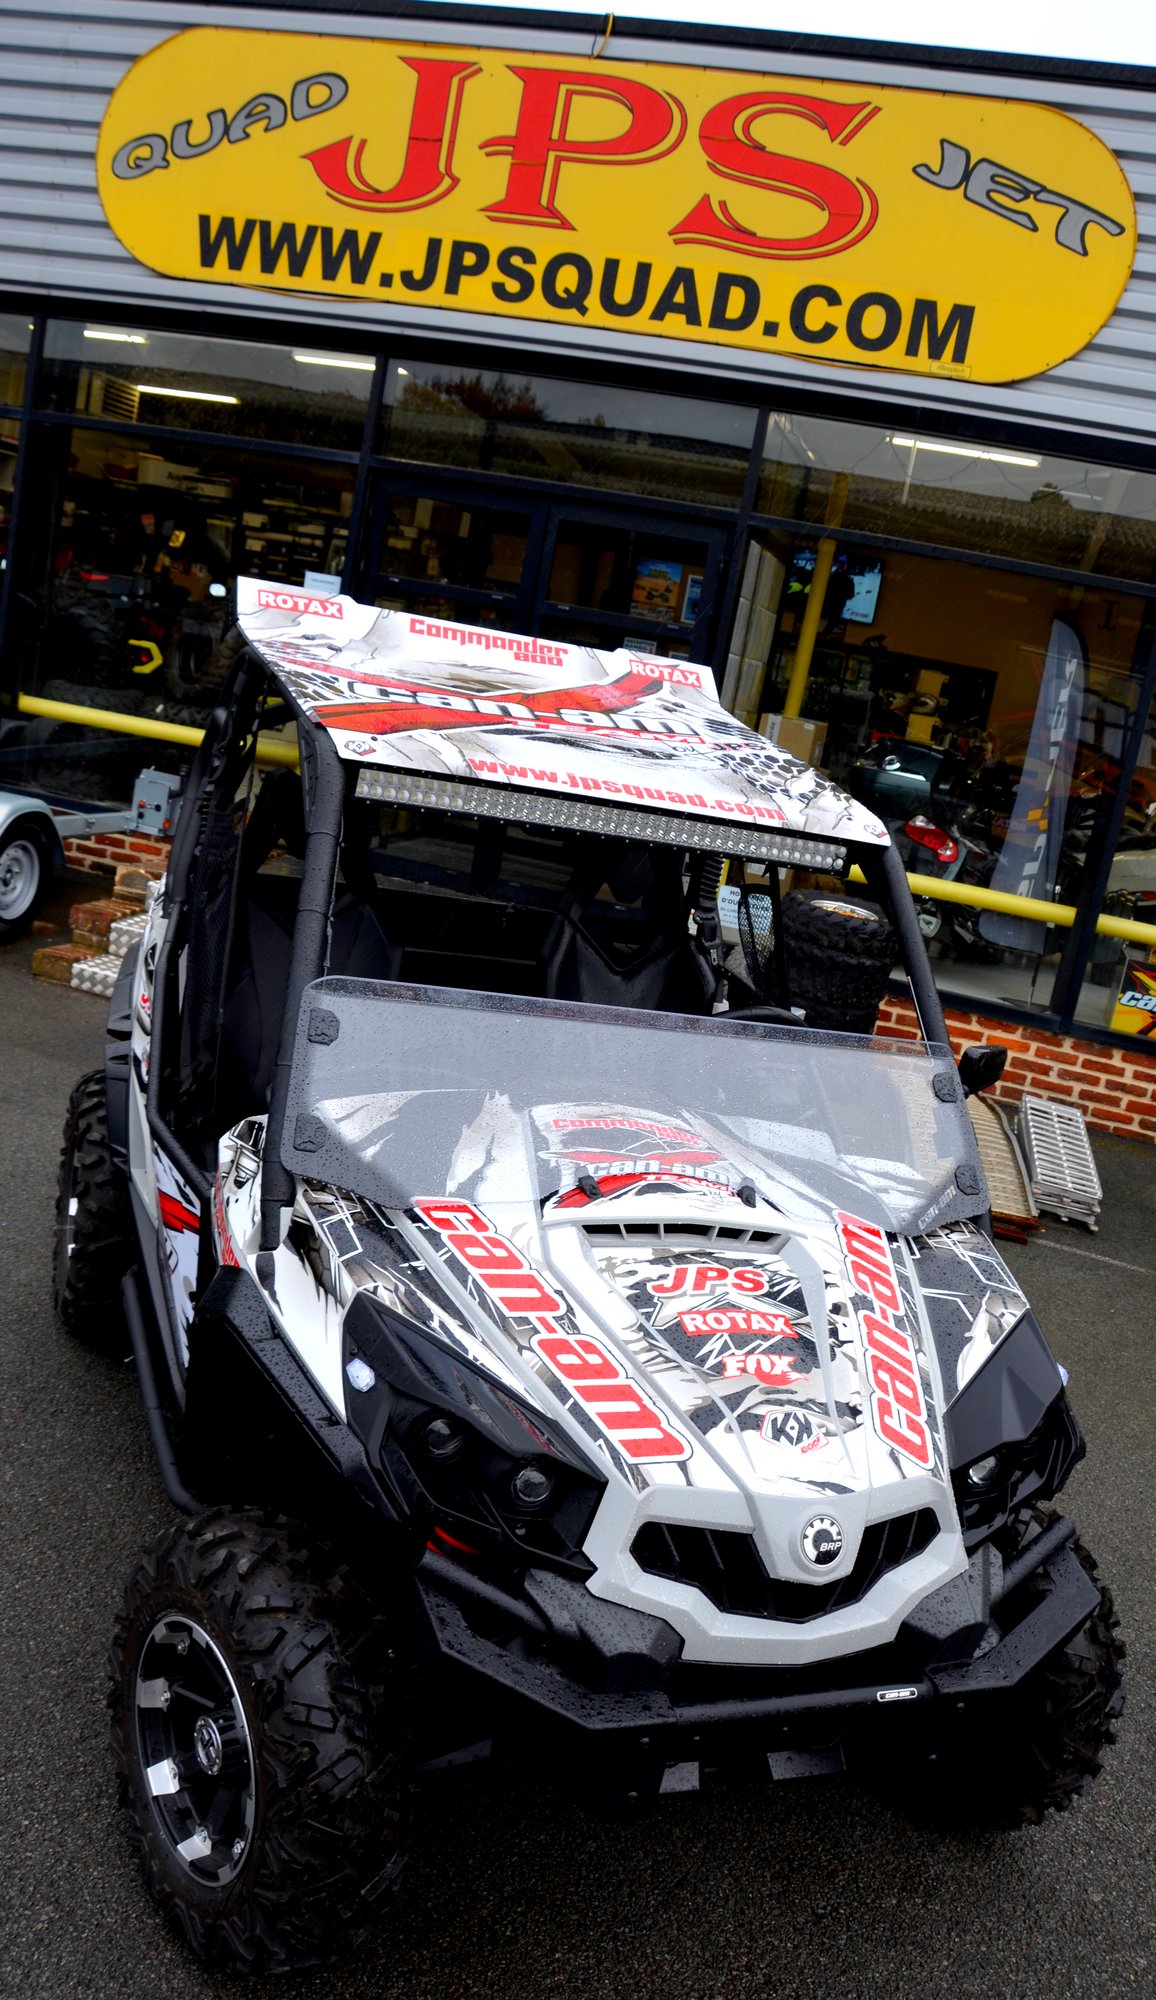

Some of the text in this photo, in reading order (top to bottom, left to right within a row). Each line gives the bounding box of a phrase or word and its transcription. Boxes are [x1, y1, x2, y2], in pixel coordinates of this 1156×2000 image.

[112, 72, 349, 180] QUAD
[300, 56, 882, 260] JPS
[912, 138, 1126, 257] JET
[198, 213, 976, 364] WWW.JPSQUAD.COM
[258, 590, 342, 619] ROTAX
[409, 617, 569, 657] Commander
[513, 651, 564, 667] 800
[630, 661, 700, 686] ROTAX
[468, 757, 786, 821] www.jpsquad.com
[651, 1266, 769, 1293] JPS
[414, 1198, 685, 1459] can-am
[681, 1312, 792, 1336] ROTAX
[836, 1211, 930, 1465] can-am
[723, 1354, 797, 1381] FOX
[819, 1541, 843, 1552] BRP
